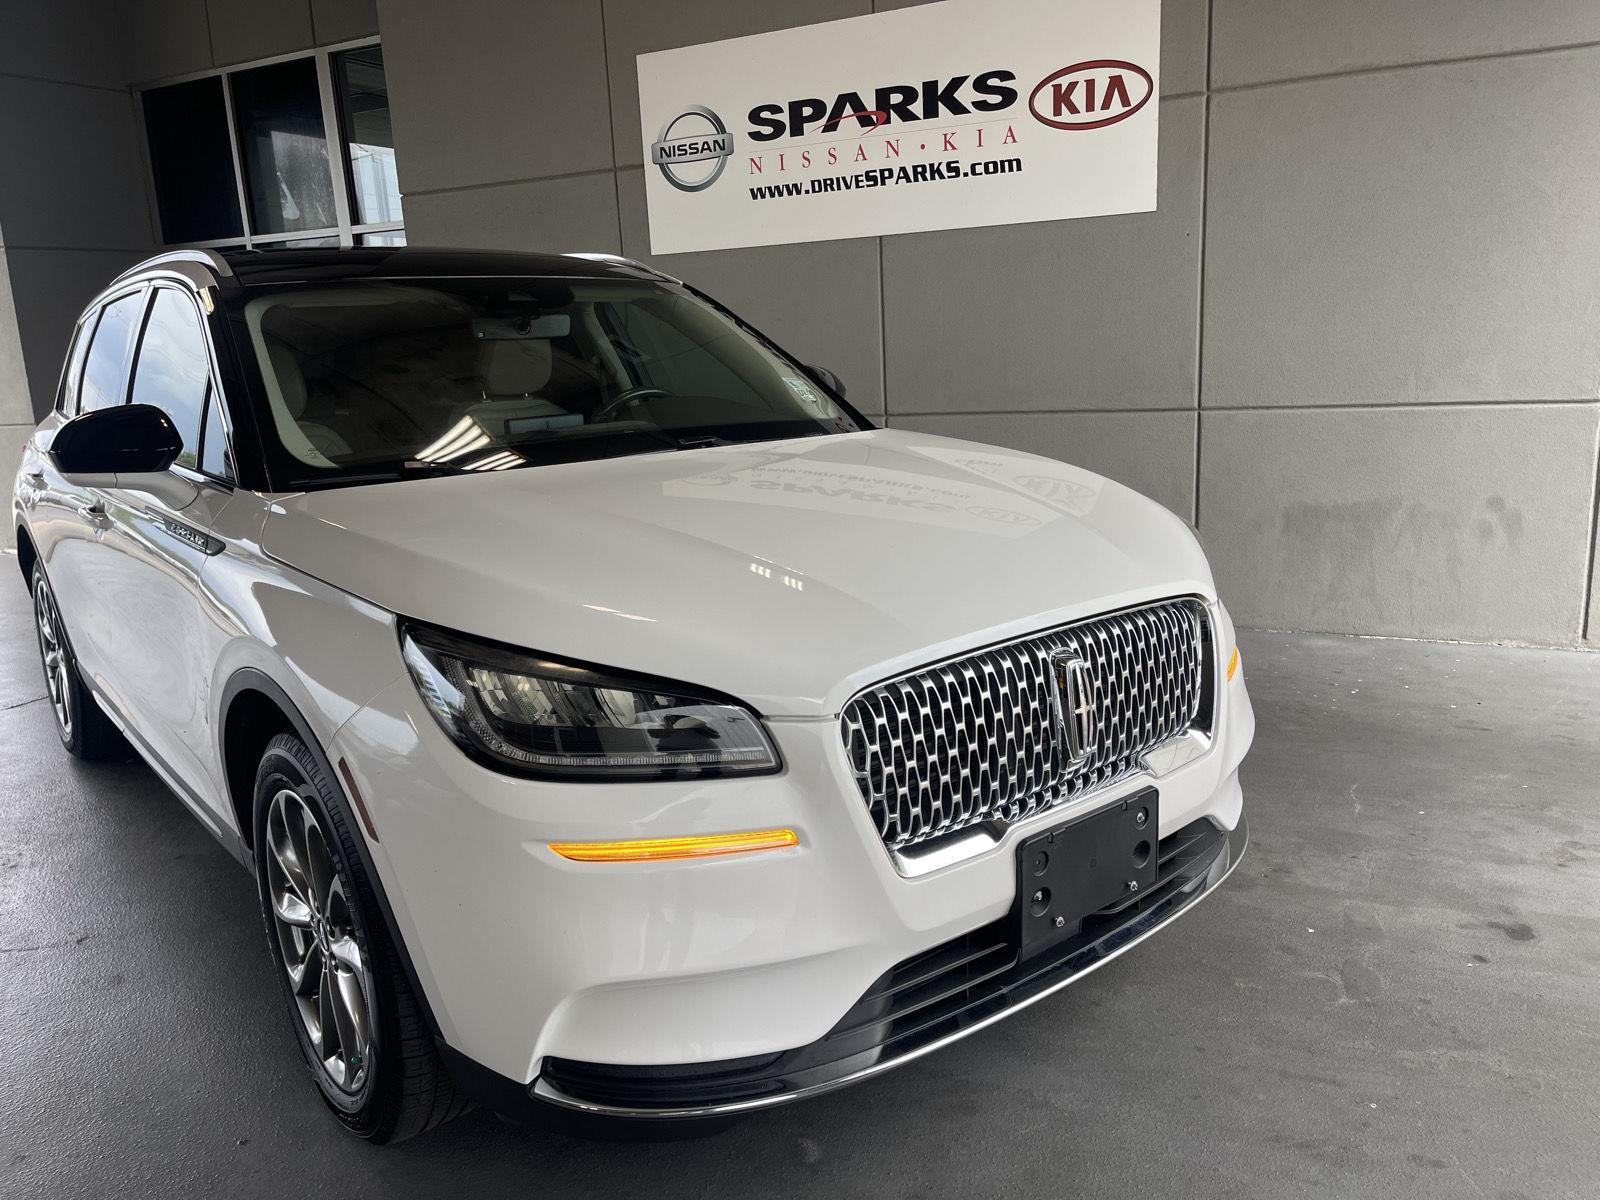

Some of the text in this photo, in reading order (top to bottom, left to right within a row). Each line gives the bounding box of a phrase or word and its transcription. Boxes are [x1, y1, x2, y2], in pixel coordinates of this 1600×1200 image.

[748, 70, 1018, 141] SPARKS
[1052, 75, 1131, 117] KIA
[660, 139, 725, 159] NISSAN
[750, 125, 1018, 174] NISSAN KIA
[750, 157, 1022, 200] www.DRIVESPARKS.com
